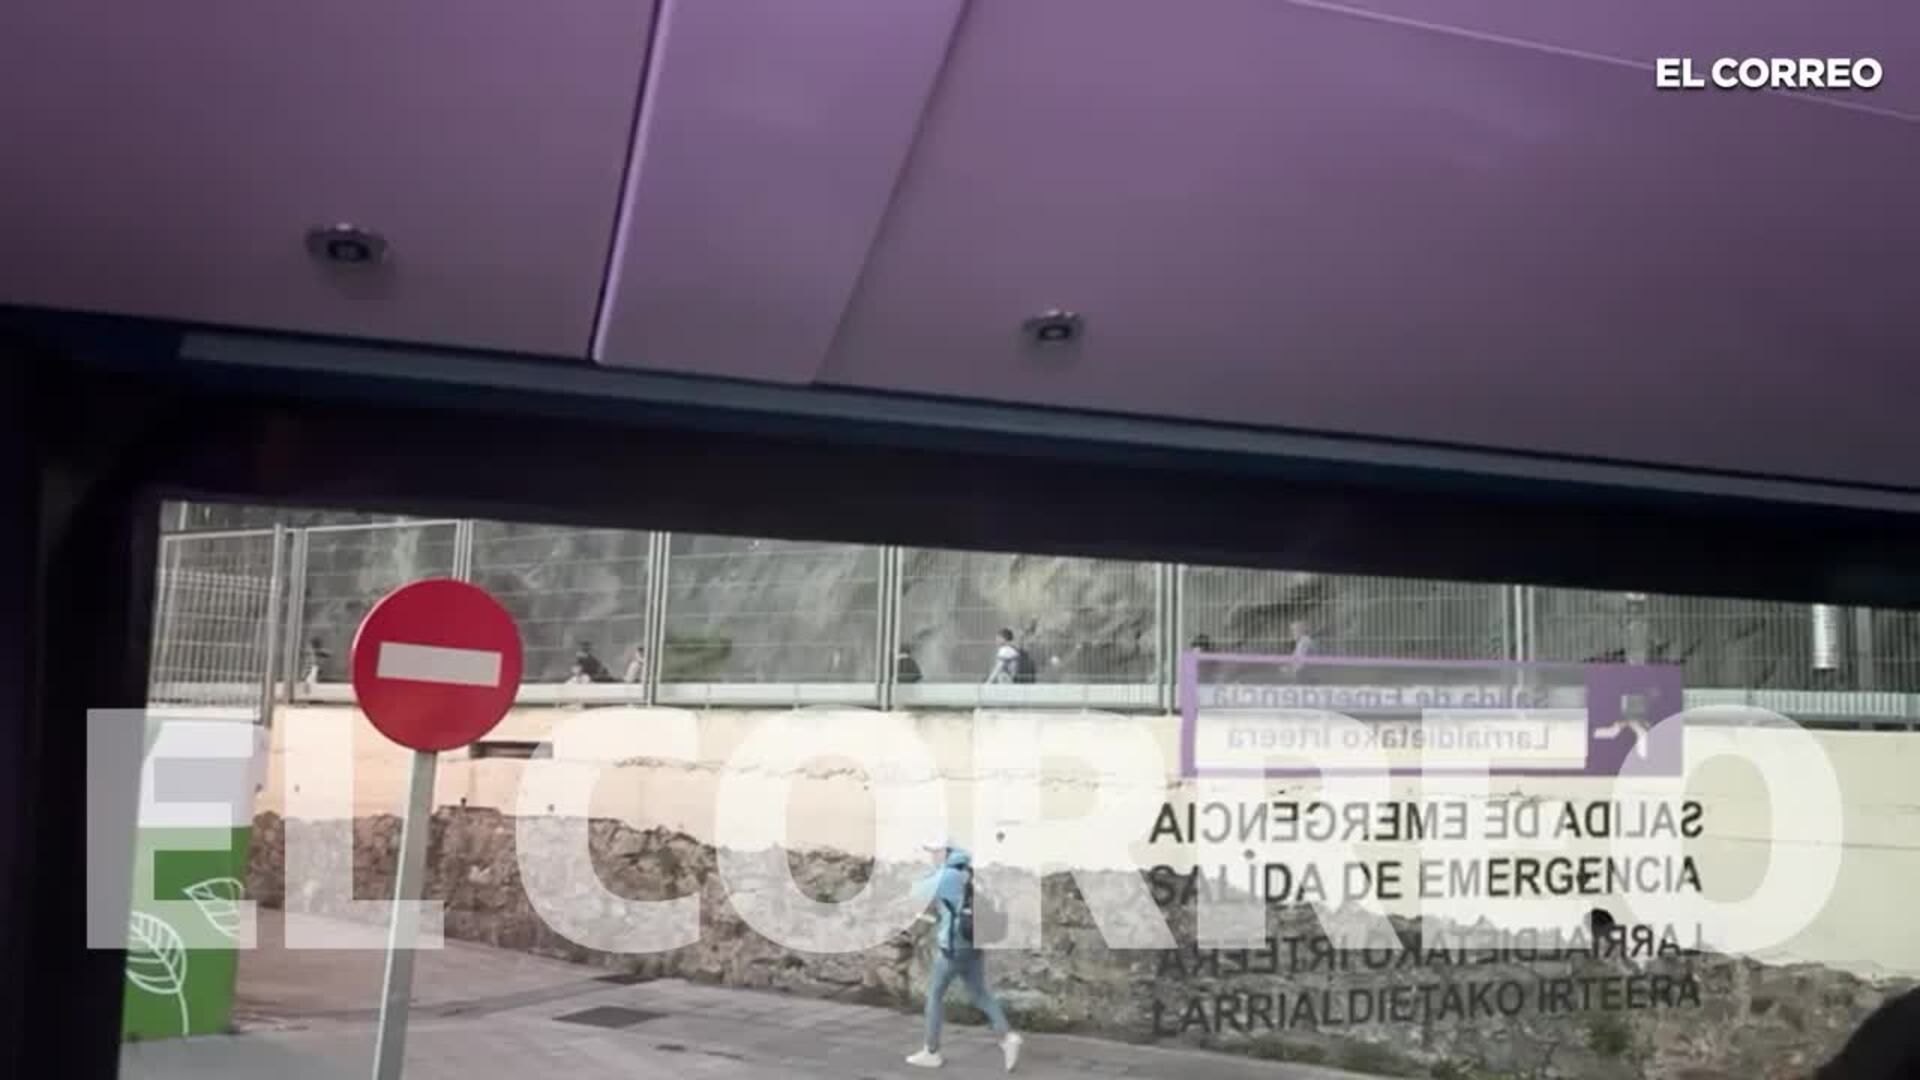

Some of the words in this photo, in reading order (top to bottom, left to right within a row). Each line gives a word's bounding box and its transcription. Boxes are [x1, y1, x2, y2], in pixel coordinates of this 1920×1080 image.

[1152, 862, 1327, 905] SALIDA
[1343, 860, 1402, 900] DE
[1419, 856, 1703, 898] EMERGENCIA
[1153, 980, 1525, 1036] LARRIALDIETAKO
[1539, 973, 1702, 1014] IRTEERA
